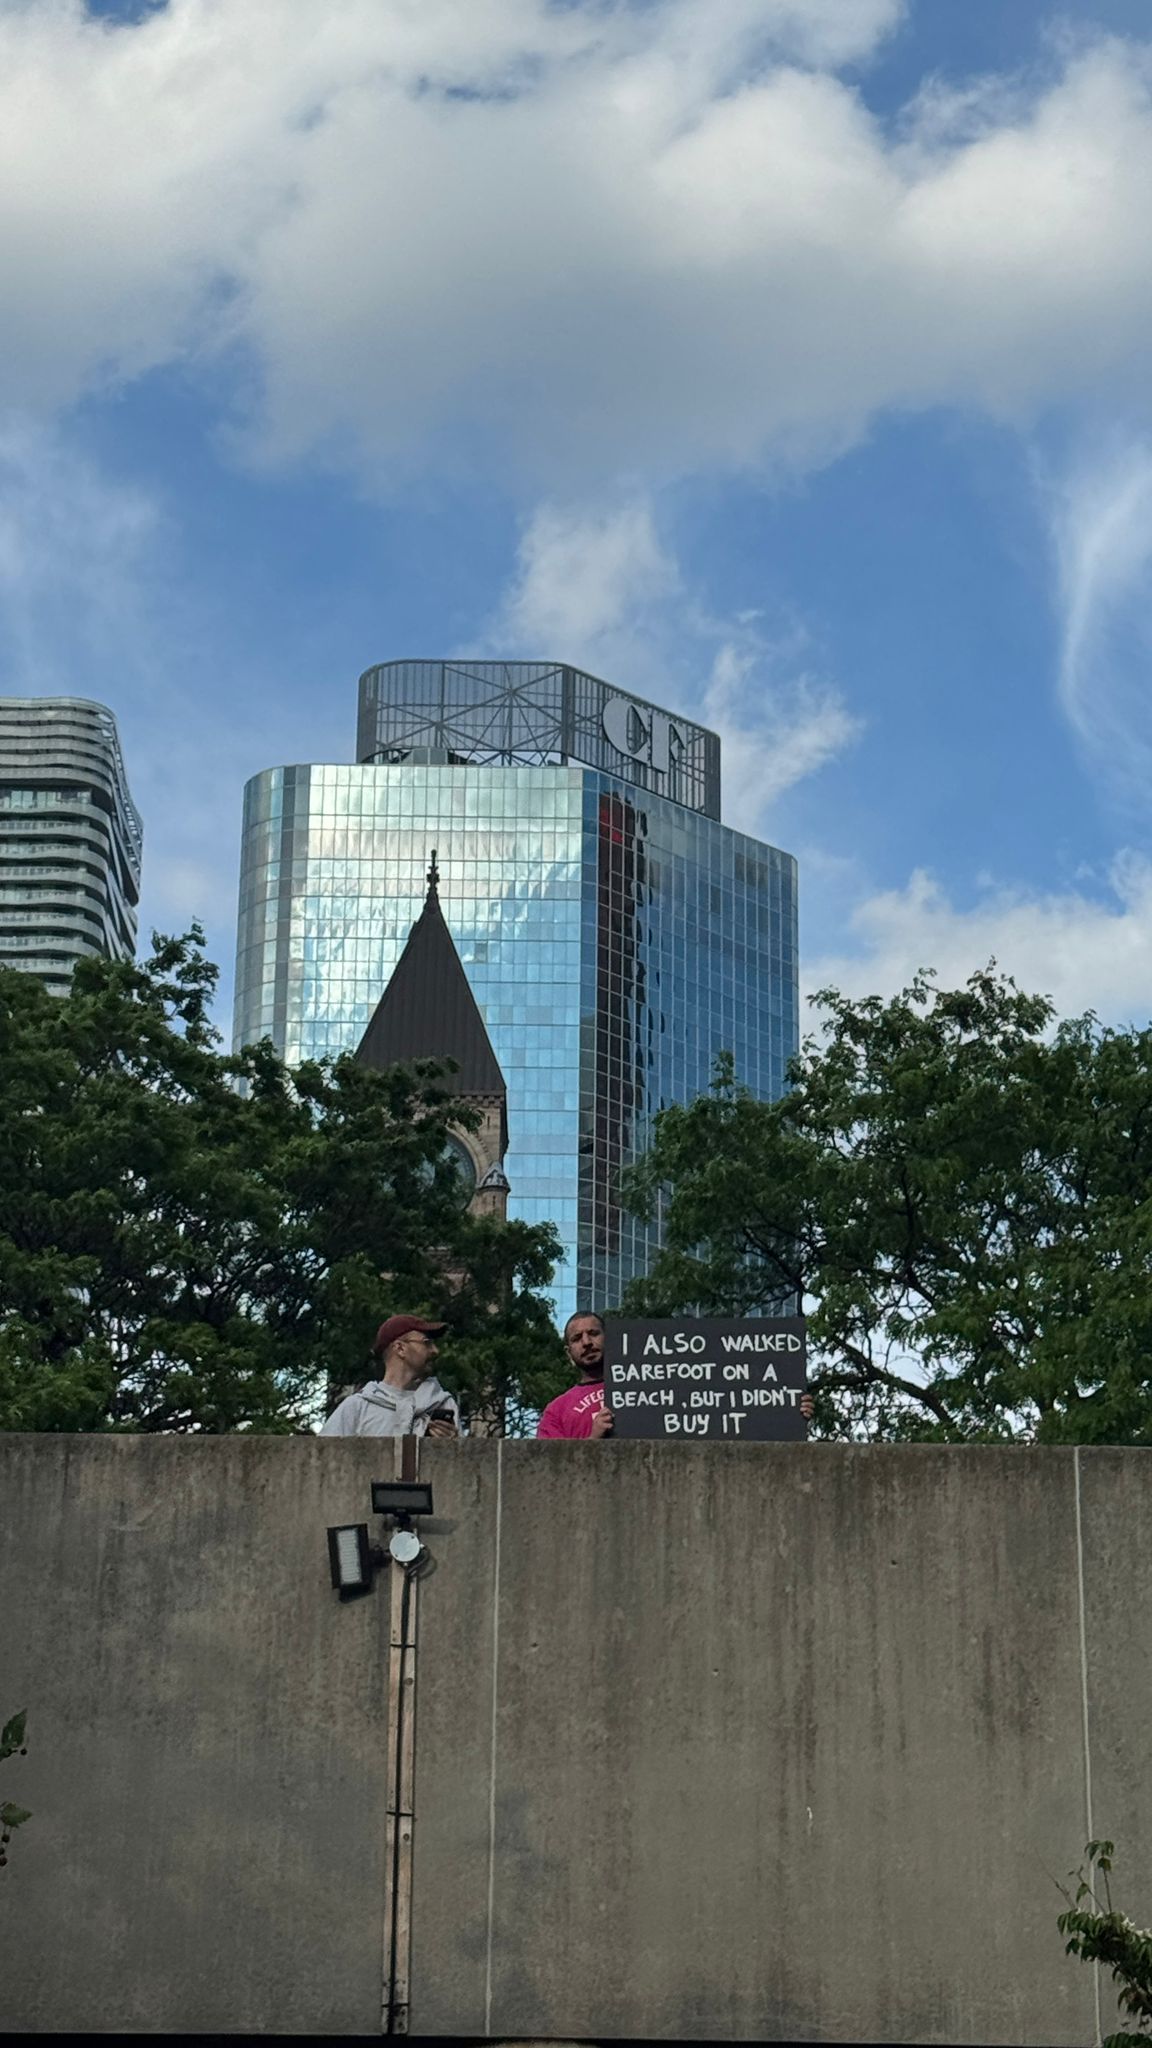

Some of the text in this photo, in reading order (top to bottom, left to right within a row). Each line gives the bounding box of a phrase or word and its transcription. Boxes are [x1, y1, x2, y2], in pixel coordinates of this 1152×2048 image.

[622, 1333, 801, 1356] I ALSO WALKED
[611, 1362, 778, 1383] BAREFOOT ON A
[573, 1389, 604, 1414] LIFEG
[729, 1390, 736, 1408] I
[741, 1386, 803, 1407] DIDN'T
[663, 1412, 747, 1435] BUY IT
